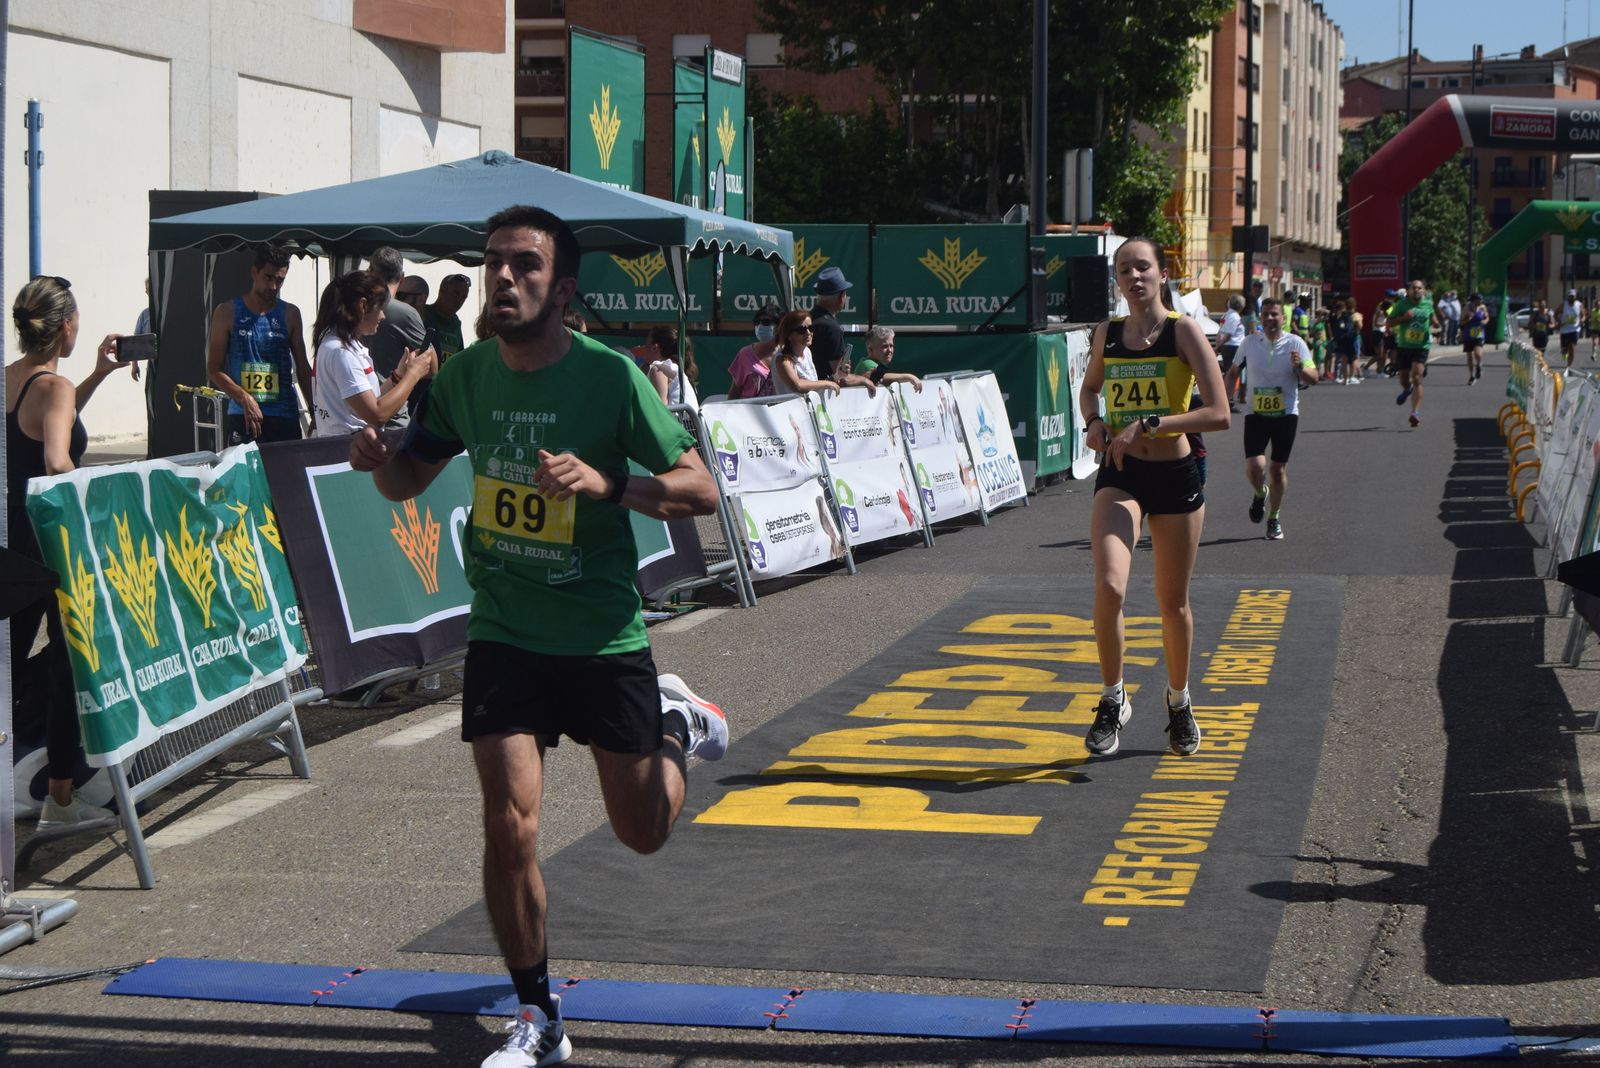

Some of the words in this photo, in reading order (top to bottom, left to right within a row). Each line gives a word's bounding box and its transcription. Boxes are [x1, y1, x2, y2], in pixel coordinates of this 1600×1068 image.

[1505, 123, 1552, 134] ZAMORA
[584, 293, 629, 310] CAJA
[635, 293, 701, 310] RURL
[793, 294, 856, 312] RUL
[891, 296, 939, 314] CAJA
[946, 296, 1016, 313] RURAL
[245, 374, 273, 390] 128
[1112, 381, 1161, 407] 244
[492, 410, 504, 421] VII
[510, 411, 557, 424] CARRERA
[503, 461, 536, 474] FUNDA
[503, 471, 525, 484] CAJA
[977, 454, 1020, 494] OCEANIC
[495, 488, 546, 533] 69
[496, 540, 521, 554] CAJA
[524, 546, 565, 561] RURAL
[154, 653, 187, 683] RURAL
[1200, 644, 1278, 685] DISEÑO
[100, 677, 131, 710] URAL
[1151, 703, 1261, 782] INTEGRAL
[1082, 790, 1230, 907] REFORMA
